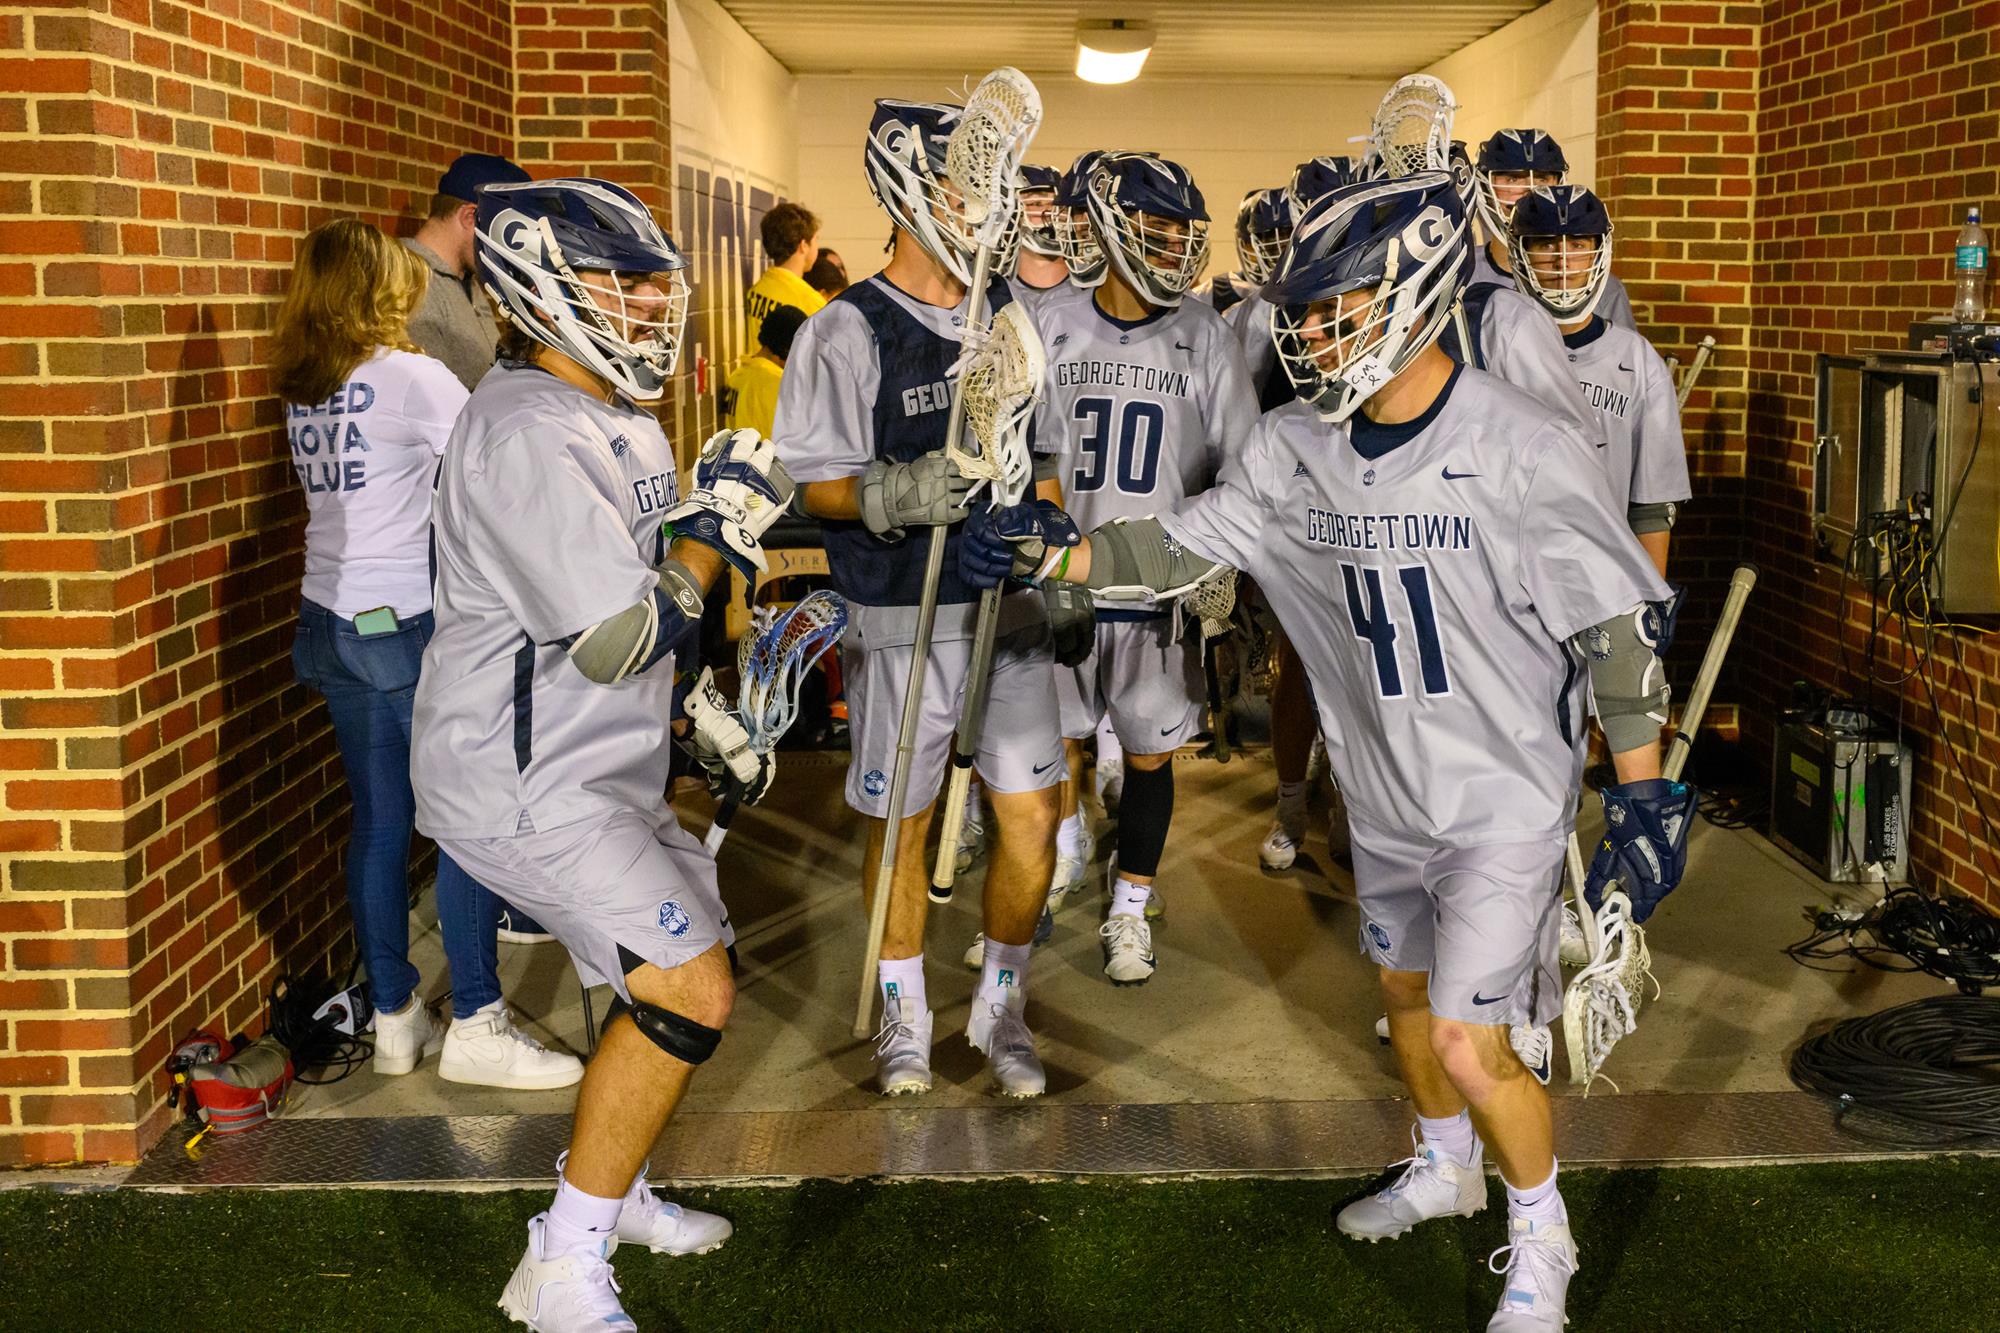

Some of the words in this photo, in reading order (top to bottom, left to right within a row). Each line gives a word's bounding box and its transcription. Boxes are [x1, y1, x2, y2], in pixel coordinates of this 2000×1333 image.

[902, 379, 957, 417] GEO
[1057, 361, 1190, 398] GEORGETOWN
[1074, 395, 1164, 498] 30
[632, 469, 680, 515] GEOR
[1307, 507, 1472, 550] GEORGETOWN
[1338, 560, 1453, 700] 41
[1884, 806, 1892, 833] BOXES
